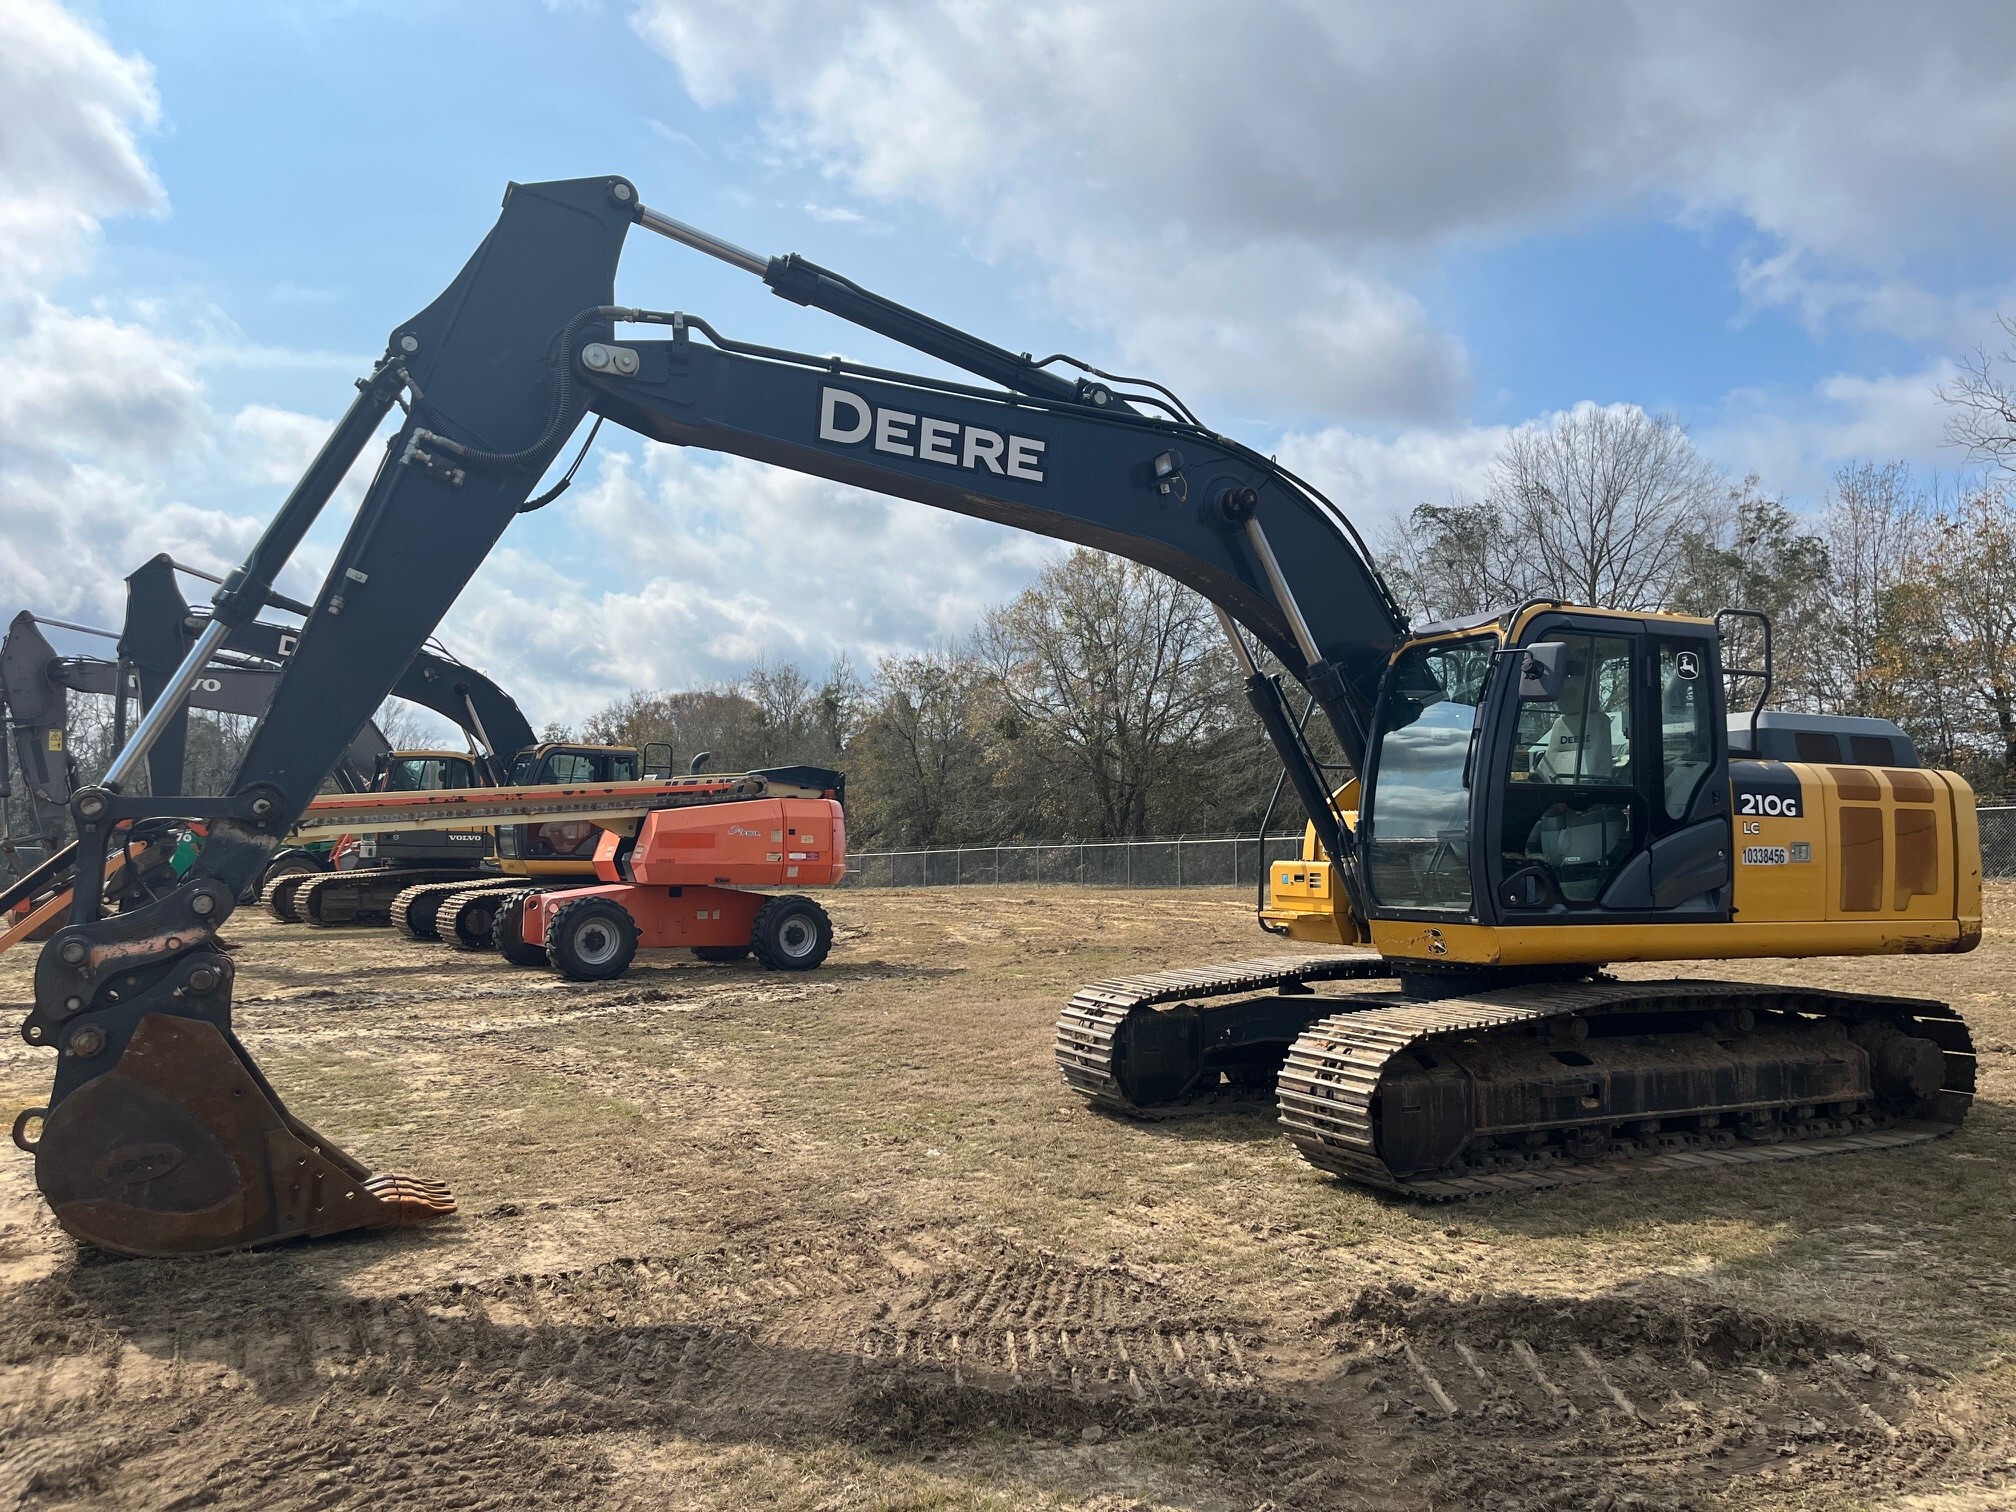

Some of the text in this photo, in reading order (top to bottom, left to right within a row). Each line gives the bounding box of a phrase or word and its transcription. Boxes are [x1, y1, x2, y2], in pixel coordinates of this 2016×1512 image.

[819, 386, 1046, 482] DEERE
[1560, 734, 1591, 745] DEEE
[1740, 793, 1796, 817] 210G
[1742, 821, 1760, 835] LC
[1742, 848, 1785, 864] 10338456
